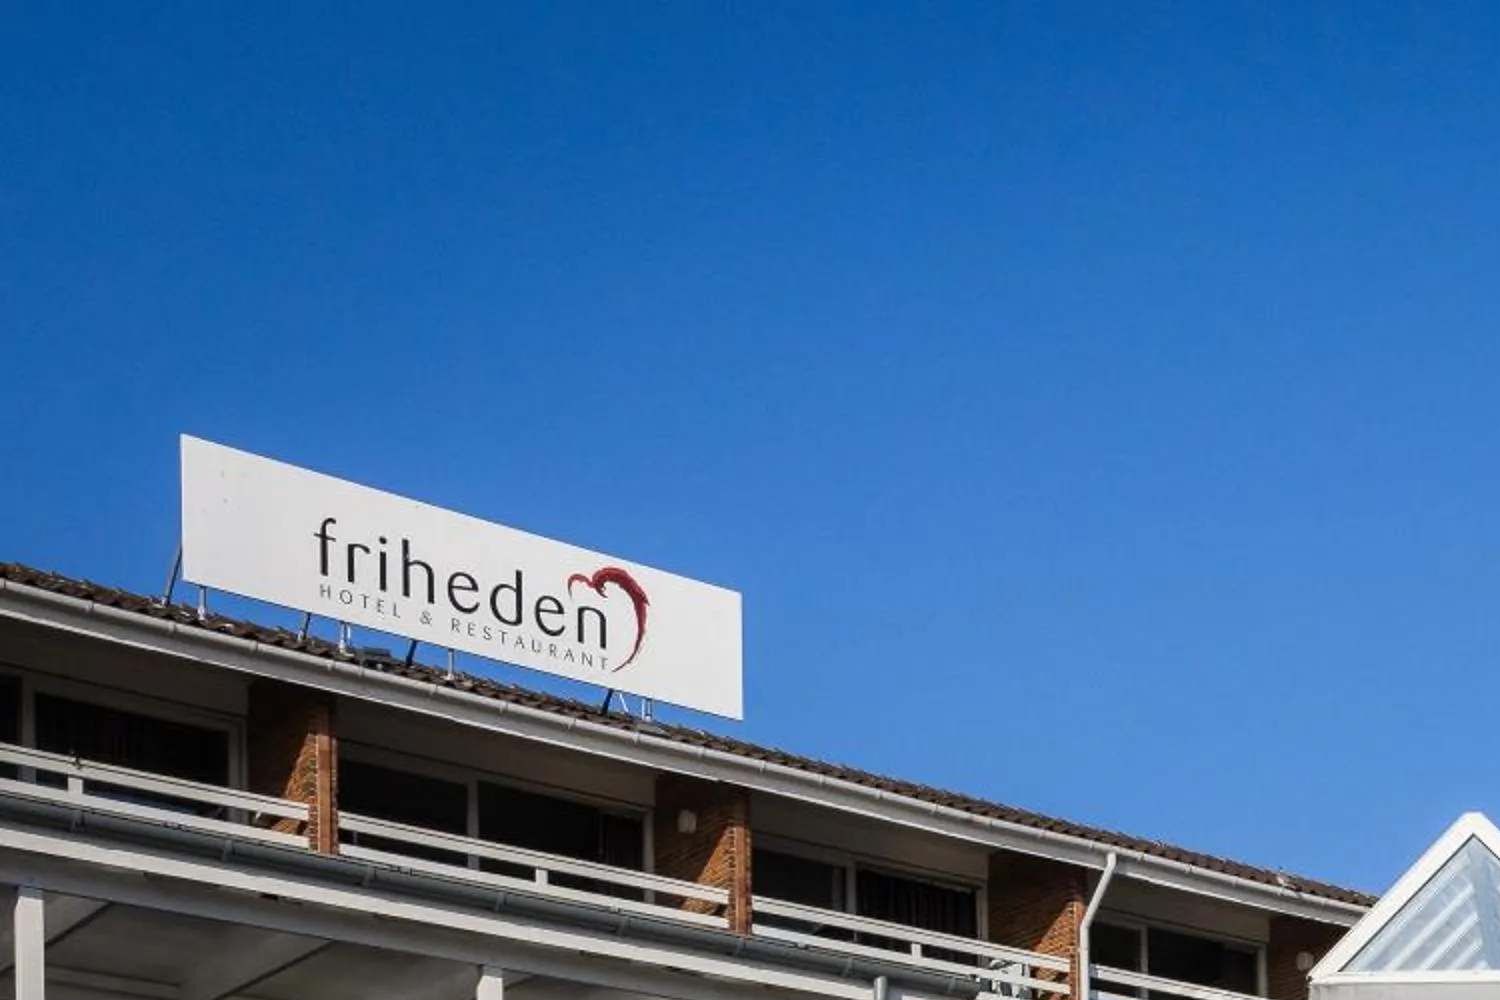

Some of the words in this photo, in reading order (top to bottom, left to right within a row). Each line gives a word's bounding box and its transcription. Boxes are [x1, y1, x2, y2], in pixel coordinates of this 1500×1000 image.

[313, 517, 607, 650] friheden
[319, 583, 401, 619] HOTEL
[419, 610, 433, 626] &
[450, 617, 609, 671] RESTAURANT
